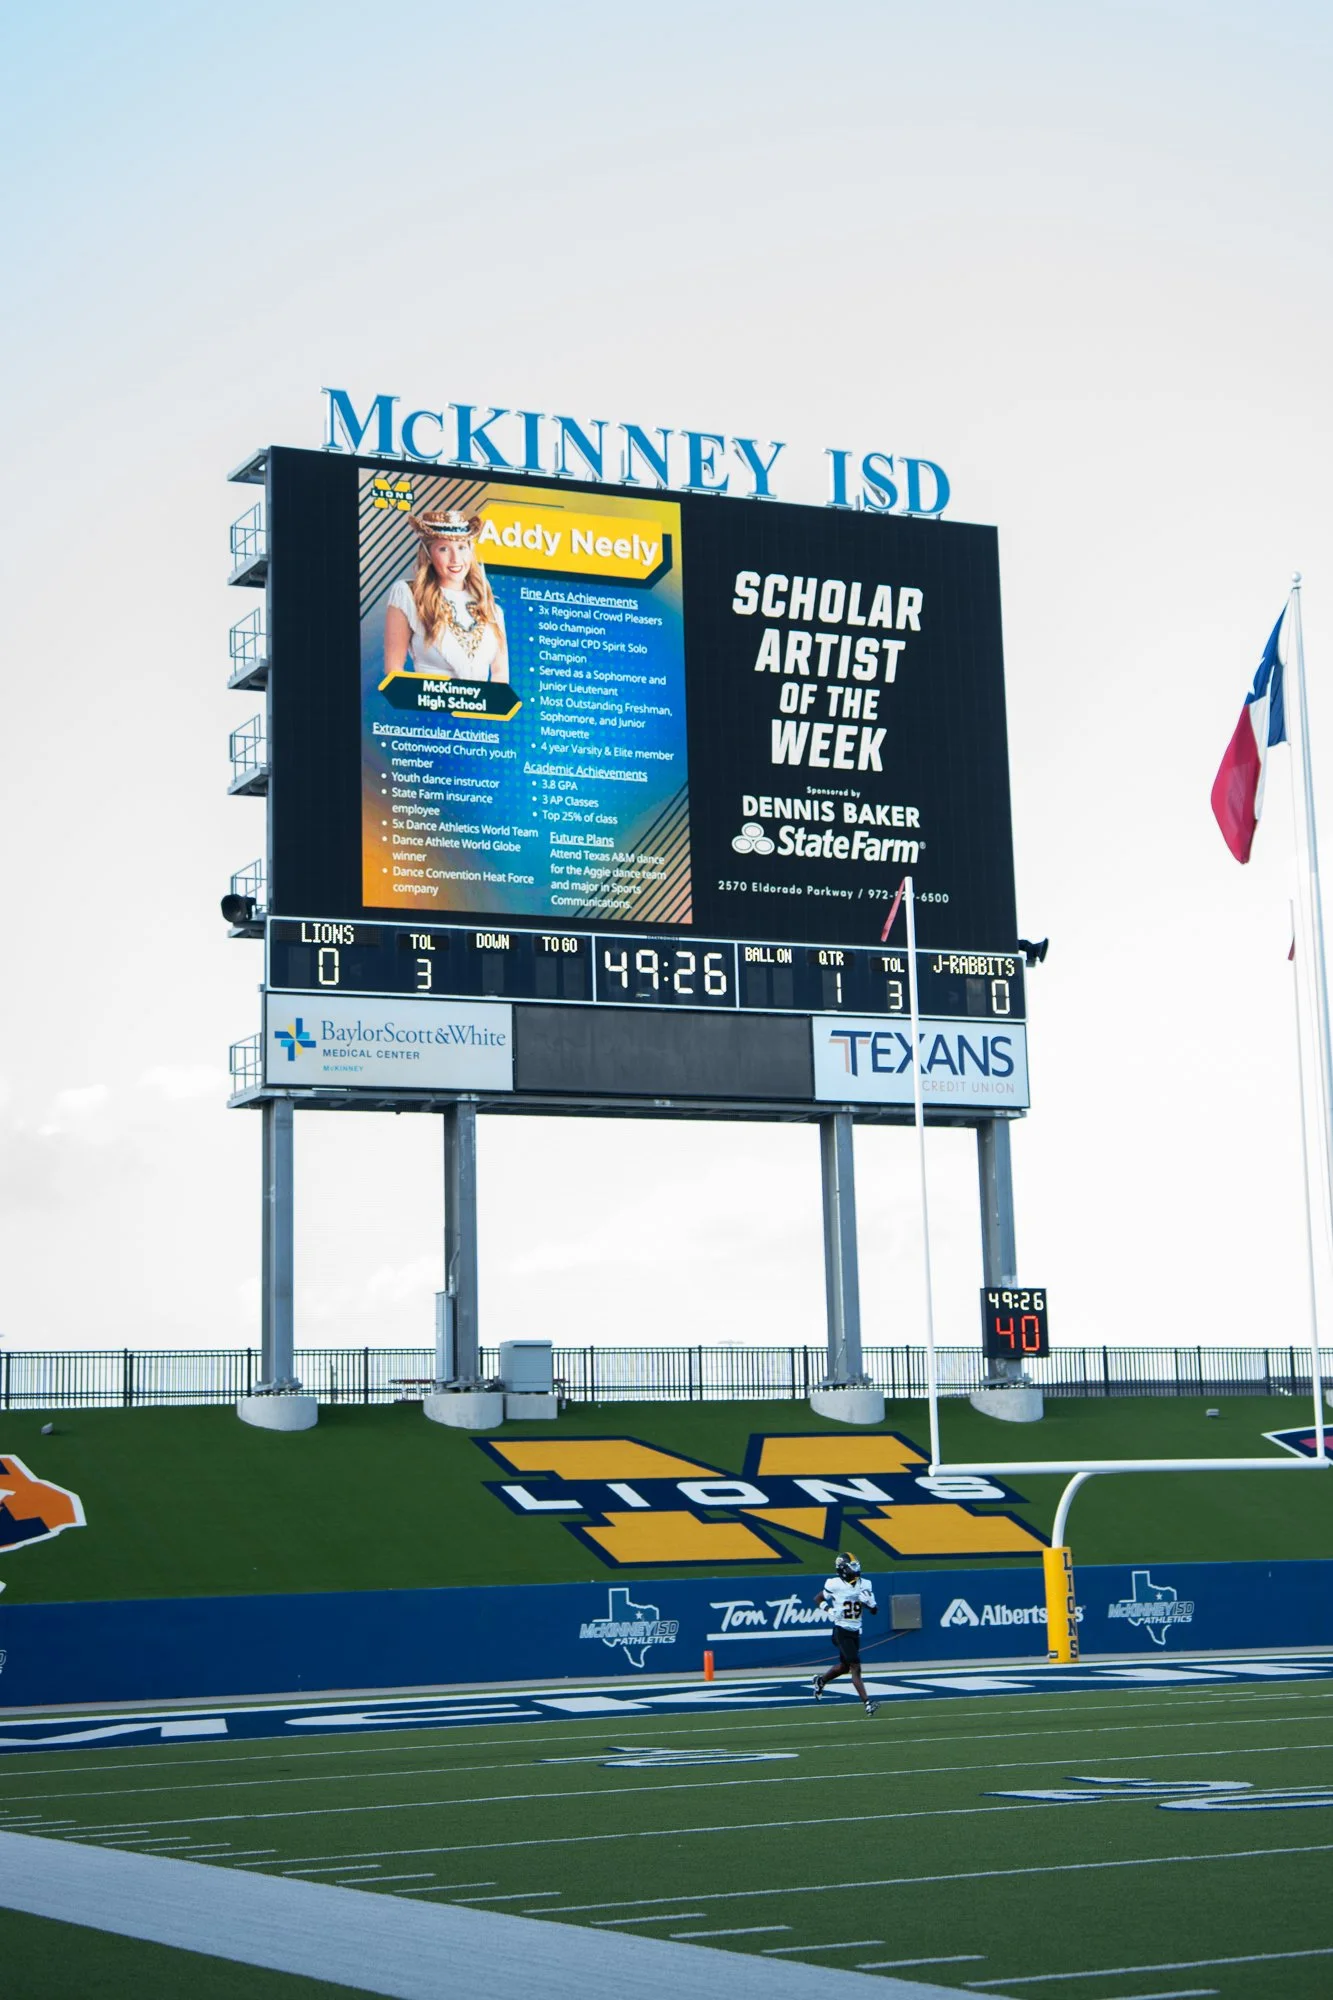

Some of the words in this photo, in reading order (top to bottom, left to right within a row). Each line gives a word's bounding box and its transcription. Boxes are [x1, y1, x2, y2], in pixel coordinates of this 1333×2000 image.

[320, 386, 786, 499] McKINNEY
[822, 448, 951, 517] ISD
[372, 490, 413, 500] LIONS
[478, 519, 561, 556] Addy
[572, 529, 659, 566] Neely
[520, 587, 542, 600] Fine
[544, 590, 565, 602] Arts
[567, 592, 639, 608] Achievements
[732, 570, 924, 631] SCHOLAR
[538, 605, 549, 615] 3x
[551, 607, 591, 619] Regional
[593, 611, 623, 622] Crowd
[625, 614, 663, 626] Pleasers
[538, 621, 558, 631] solo
[559, 622, 606, 635] champion
[538, 635, 579, 648] Regional
[581, 639, 600, 650] CPD
[602, 642, 626, 653] Spirit
[627, 643, 647, 654] Solo
[539, 651, 587, 664] Champion
[754, 628, 906, 683] ARTIST
[539, 666, 571, 677] Served
[593, 670, 647, 684] Sophomore
[649, 676, 667, 685] and
[423, 680, 481, 698] McKinney
[539, 681, 567, 692] Junior
[569, 683, 618, 696] Lieutenant
[418, 695, 446, 710] High
[447, 698, 487, 711] School
[540, 696, 563, 707] Most
[565, 698, 623, 714] Outstanding
[625, 705, 673, 717] Freshman,
[779, 682, 818, 715] OF
[827, 685, 881, 721] THE
[540, 712, 597, 726] Sophomore,
[599, 716, 617, 726] and
[618, 718, 646, 729] Junior
[372, 722, 451, 738] Extracurricular
[453, 729, 500, 742] Activities
[541, 726, 589, 739] Marquette
[391, 740, 450, 754] Cottonwood
[453, 746, 487, 757] Church
[489, 749, 517, 760] youth
[541, 742, 547, 750] 4
[549, 744, 569, 754] year
[571, 744, 602, 757] Varsity
[604, 747, 612, 756] &
[613, 747, 633, 757] Elite
[635, 750, 675, 761] member
[771, 719, 887, 772] WEEK
[392, 758, 434, 769] member
[523, 761, 573, 774] Academic
[576, 765, 648, 781] Achievements
[391, 772, 420, 783] Youth
[422, 773, 451, 785] dance
[454, 775, 500, 789] instructor
[542, 779, 556, 789] 3.8
[557, 780, 578, 790] GPA
[392, 788, 417, 799] State
[419, 789, 445, 800] Farm
[446, 791, 493, 804] insurance
[806, 786, 849, 797] Sponsored
[851, 789, 861, 798] by
[392, 804, 440, 817] employee
[542, 795, 548, 805] 3
[550, 795, 563, 805] AP
[565, 796, 599, 808] Classes
[542, 809, 560, 821] Top
[562, 811, 582, 821] 25%
[583, 811, 595, 822] of
[595, 814, 618, 825] class
[742, 795, 835, 822] DENNIS
[843, 802, 920, 828] BAKER
[392, 819, 405, 829] 5x
[406, 820, 437, 831] Dance
[438, 822, 480, 834] Athletics
[481, 825, 510, 836] World
[512, 826, 538, 838] Team
[392, 835, 423, 846] Dance
[425, 836, 460, 848] Athlete
[461, 838, 491, 850] World
[492, 840, 521, 852] Globe
[550, 832, 584, 844] Future
[586, 833, 614, 846] Plans
[392, 852, 427, 862] winner
[550, 849, 582, 860] Attend
[583, 850, 610, 862] Texas
[611, 853, 635, 863] A&M
[637, 854, 665, 864] dance
[393, 866, 424, 877] Dance
[425, 868, 482, 881] Convention
[483, 871, 506, 882] Heat
[507, 872, 534, 884] Force
[550, 864, 564, 874] for
[566, 865, 582, 875] the
[583, 867, 611, 879] Aggie
[612, 869, 641, 879] dance
[642, 870, 667, 880] team
[393, 883, 439, 896] company
[550, 880, 569, 890] and
[571, 882, 599, 893] major
[600, 882, 610, 891] in
[611, 884, 641, 895] Sports
[718, 880, 748, 892] 2570
[752, 882, 802, 895] Eldorado
[807, 885, 853, 899] Parkway
[868, 889, 949, 903] 972-2-6500
[551, 895, 633, 909] Communications.
[301, 923, 354, 945] LIONS
[409, 934, 435, 951] TOL
[475, 933, 510, 950] DOWN
[745, 947, 774, 964] BALL
[776, 948, 792, 964] ON
[818, 951, 844, 967] QTR
[318, 947, 339, 985] 0
[416, 958, 432, 989] 3
[604, 949, 727, 996] 49:26
[881, 957, 905, 973] TOL
[933, 954, 1015, 977] J-RABBITS
[836, 972, 843, 1004] 1
[888, 980, 903, 1010] 3
[991, 979, 1011, 1015] 0
[322, 1049, 372, 1058] MEDICAL
[376, 1050, 420, 1060] CENTER
[828, 1030, 1015, 1078] TEXANS
[922, 1080, 966, 1093] CREDIT
[972, 1082, 1015, 1094] UNION
[988, 1291, 1044, 1311] 49:26
[996, 1315, 1040, 1351] 40
[501, 1475, 1006, 1511] LIONS
[709, 1600, 768, 1632] Tom
[765, 1594, 835, 1630] Thum
[843, 1601, 862, 1619] 29
[980, 1604, 1084, 1626] Albertss
[1143, 1615, 1193, 1624] ATHLETICS
[621, 1636, 676, 1645] ATHLETICS
